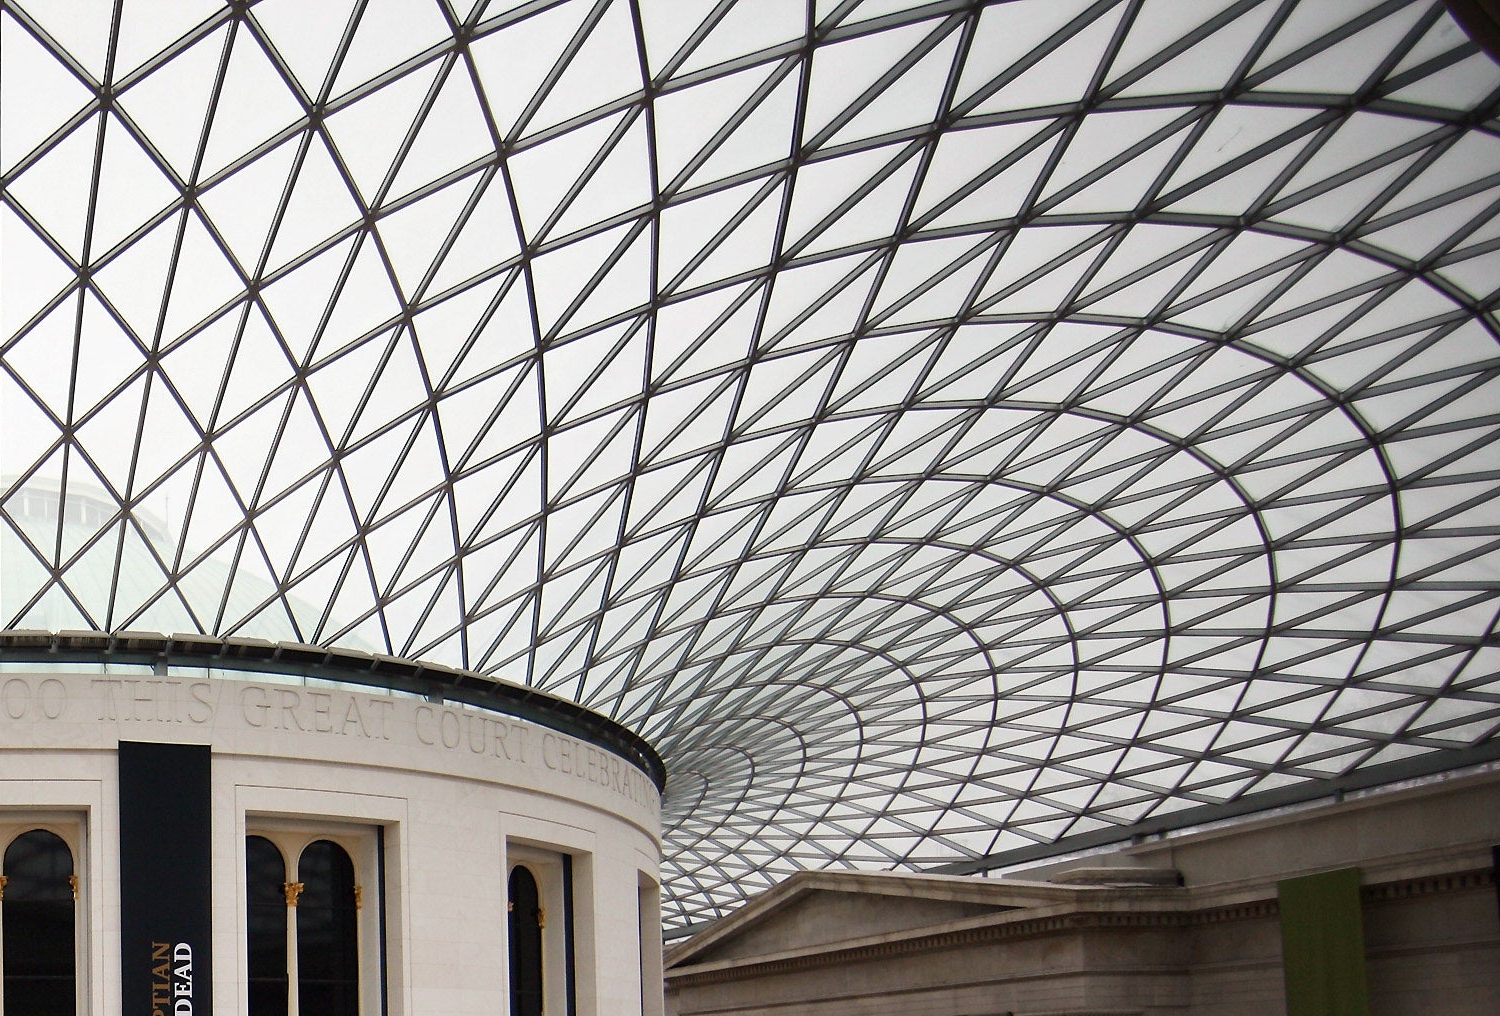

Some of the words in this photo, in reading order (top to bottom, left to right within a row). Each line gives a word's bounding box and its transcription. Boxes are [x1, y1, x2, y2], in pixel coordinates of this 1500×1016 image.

[91, 679, 213, 724] THIS
[240, 686, 394, 741] GREAT
[414, 706, 529, 765] COURT
